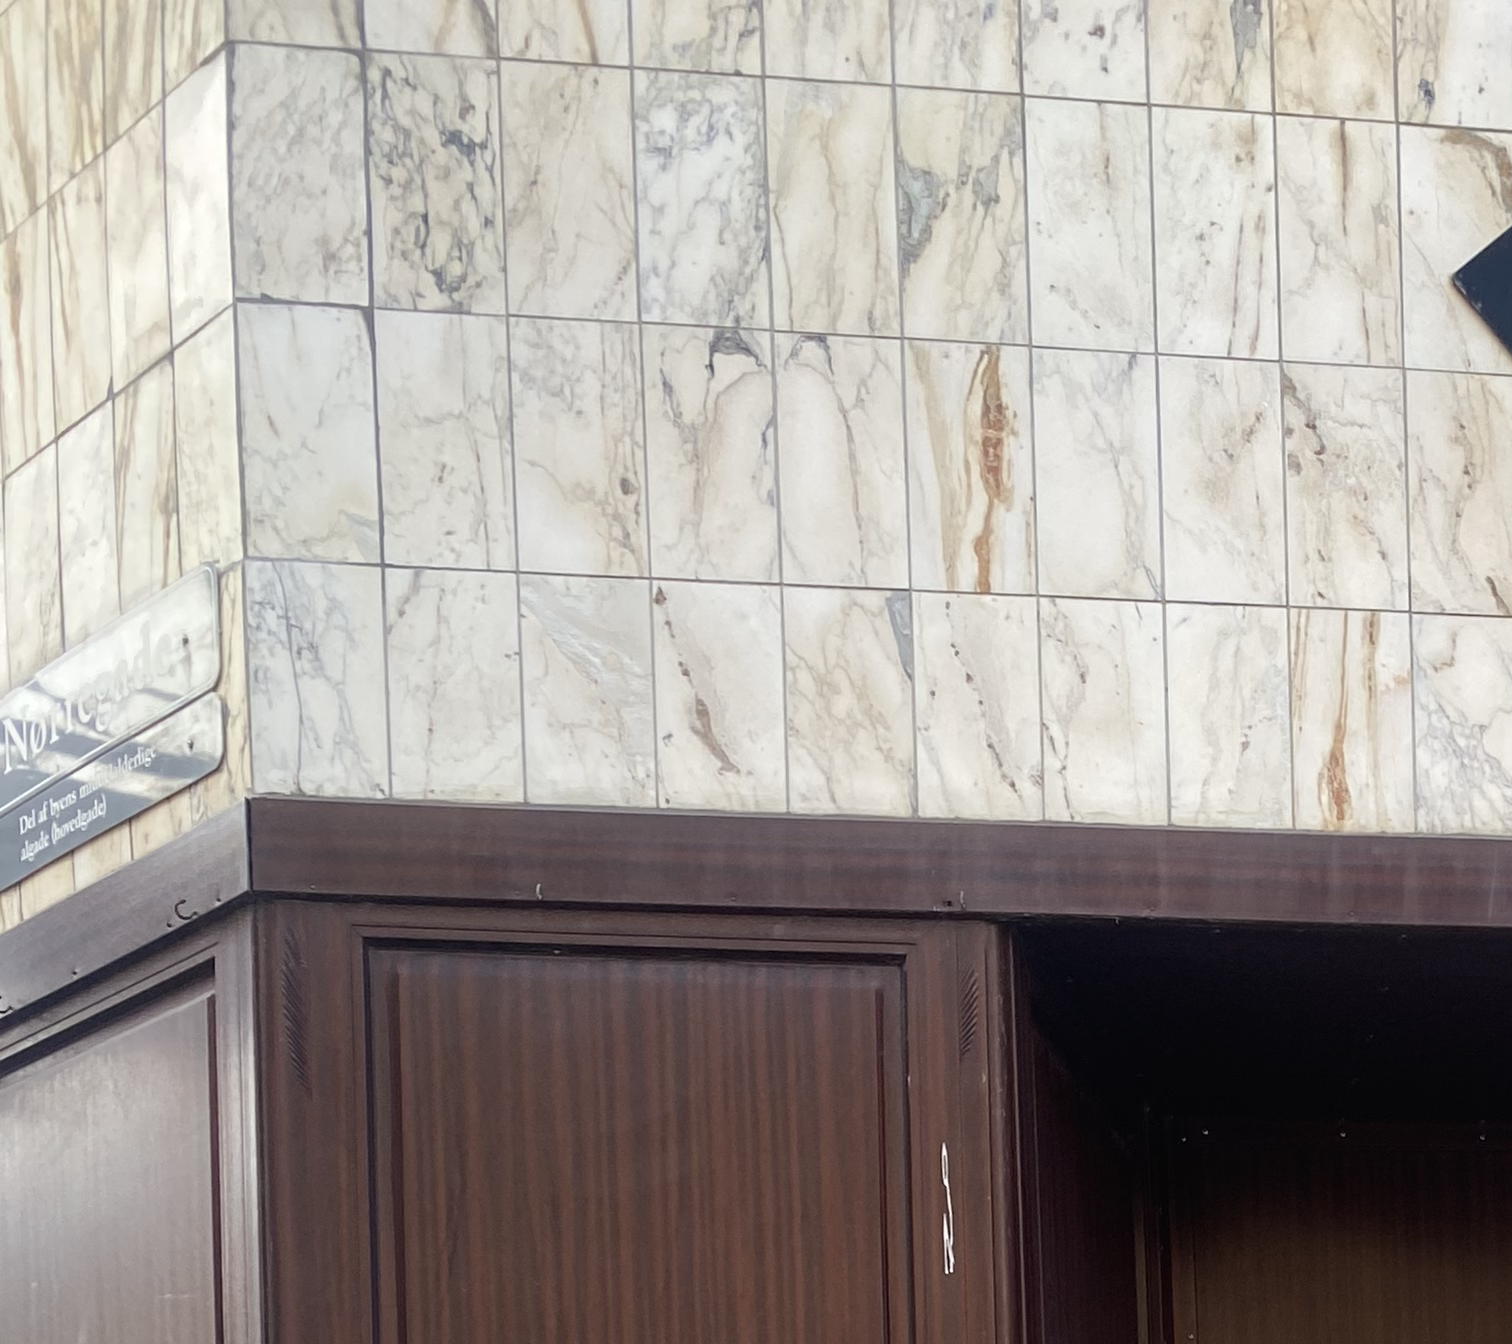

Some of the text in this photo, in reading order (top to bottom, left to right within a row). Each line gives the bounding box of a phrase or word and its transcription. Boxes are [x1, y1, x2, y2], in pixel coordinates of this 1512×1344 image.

[2, 620, 177, 776] Nørregade
[19, 814, 36, 835] Del
[50, 789, 77, 818] byens
[20, 833, 50, 862] algade
